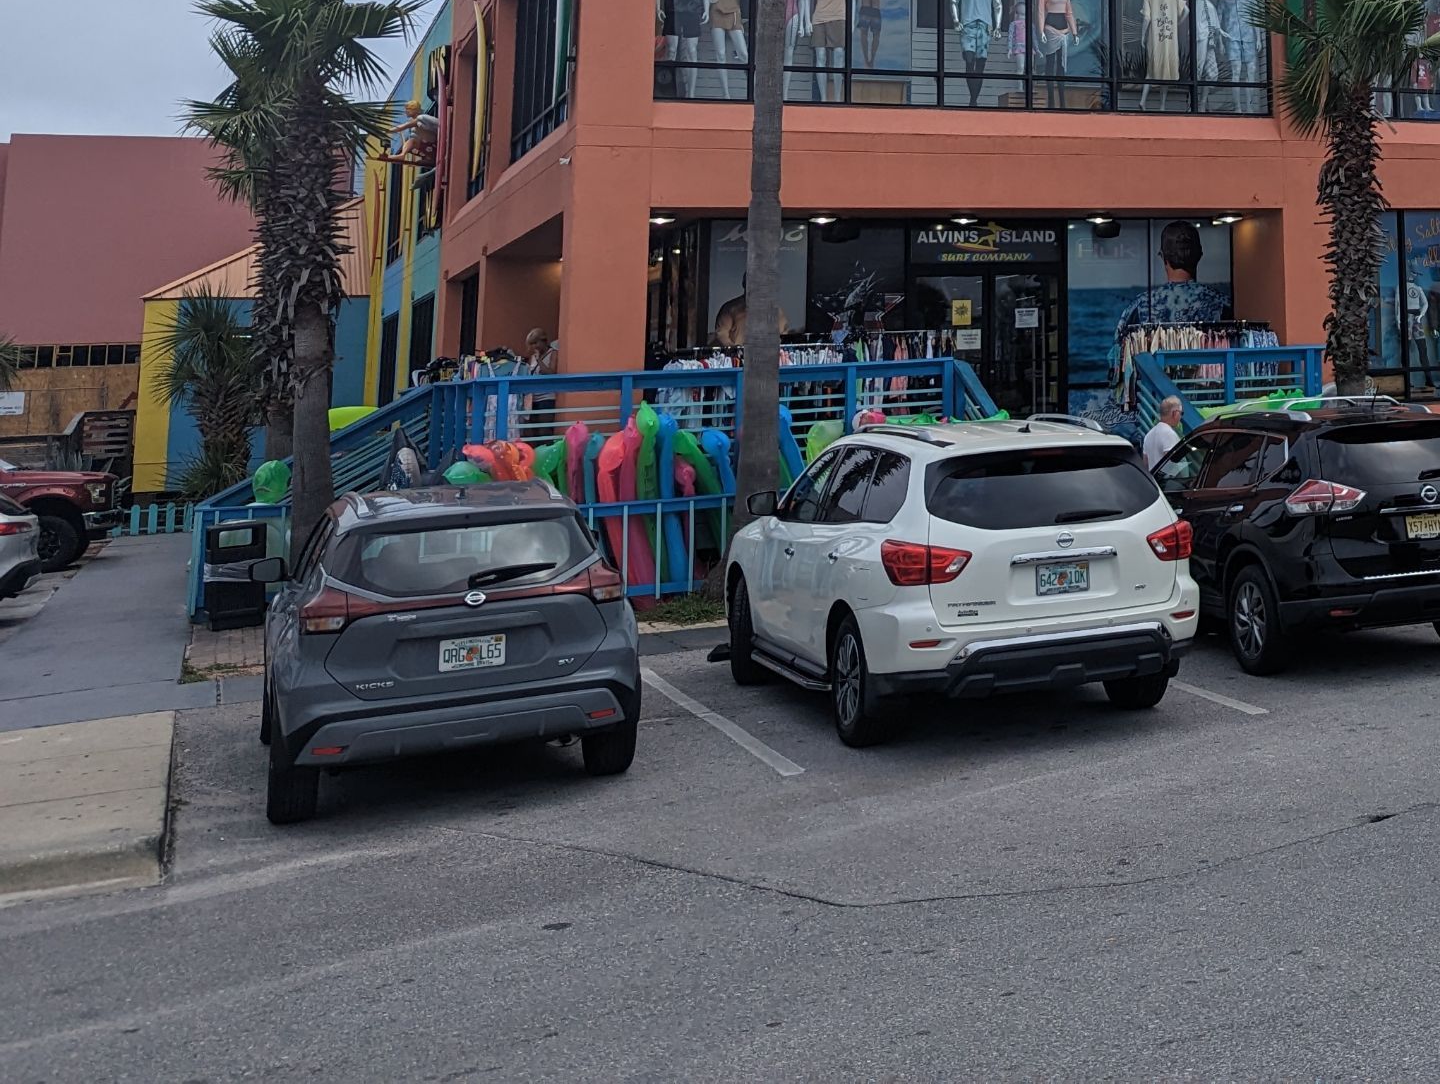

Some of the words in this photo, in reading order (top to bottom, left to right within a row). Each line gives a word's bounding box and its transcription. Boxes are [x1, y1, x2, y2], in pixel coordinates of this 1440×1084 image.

[917, 230, 979, 244] ALVIN'S
[996, 230, 1056, 243] ISLAND
[941, 253, 970, 262] SURF
[972, 252, 1031, 261] COMPANY
[1408, 520, 1423, 533] X57
[1040, 572, 1057, 587] 642
[479, 643, 502, 660] L65
[355, 680, 394, 690] KICKS
